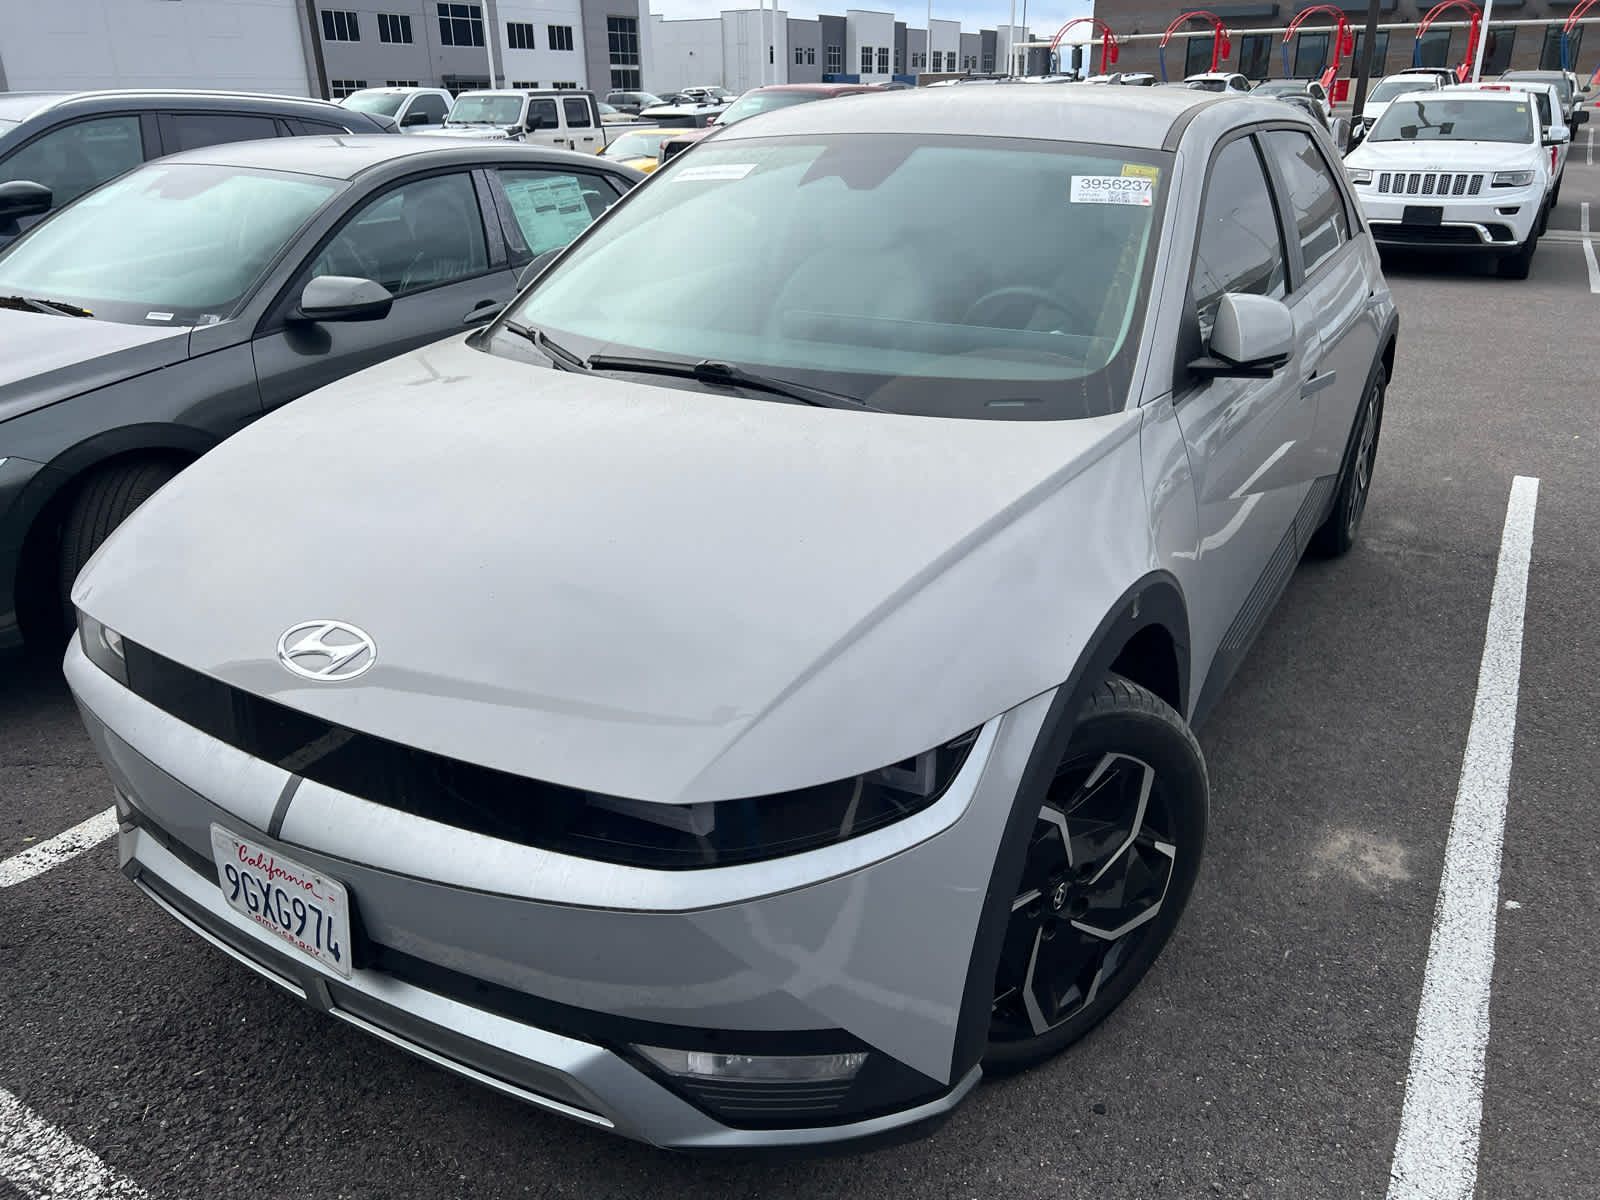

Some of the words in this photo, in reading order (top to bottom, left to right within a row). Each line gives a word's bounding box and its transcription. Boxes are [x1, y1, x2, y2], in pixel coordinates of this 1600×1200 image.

[1081, 178, 1152, 192] 3956237
[239, 845, 322, 900] California
[225, 864, 340, 962] 9GXG974
[255, 914, 320, 956] dmv.ca.gov
